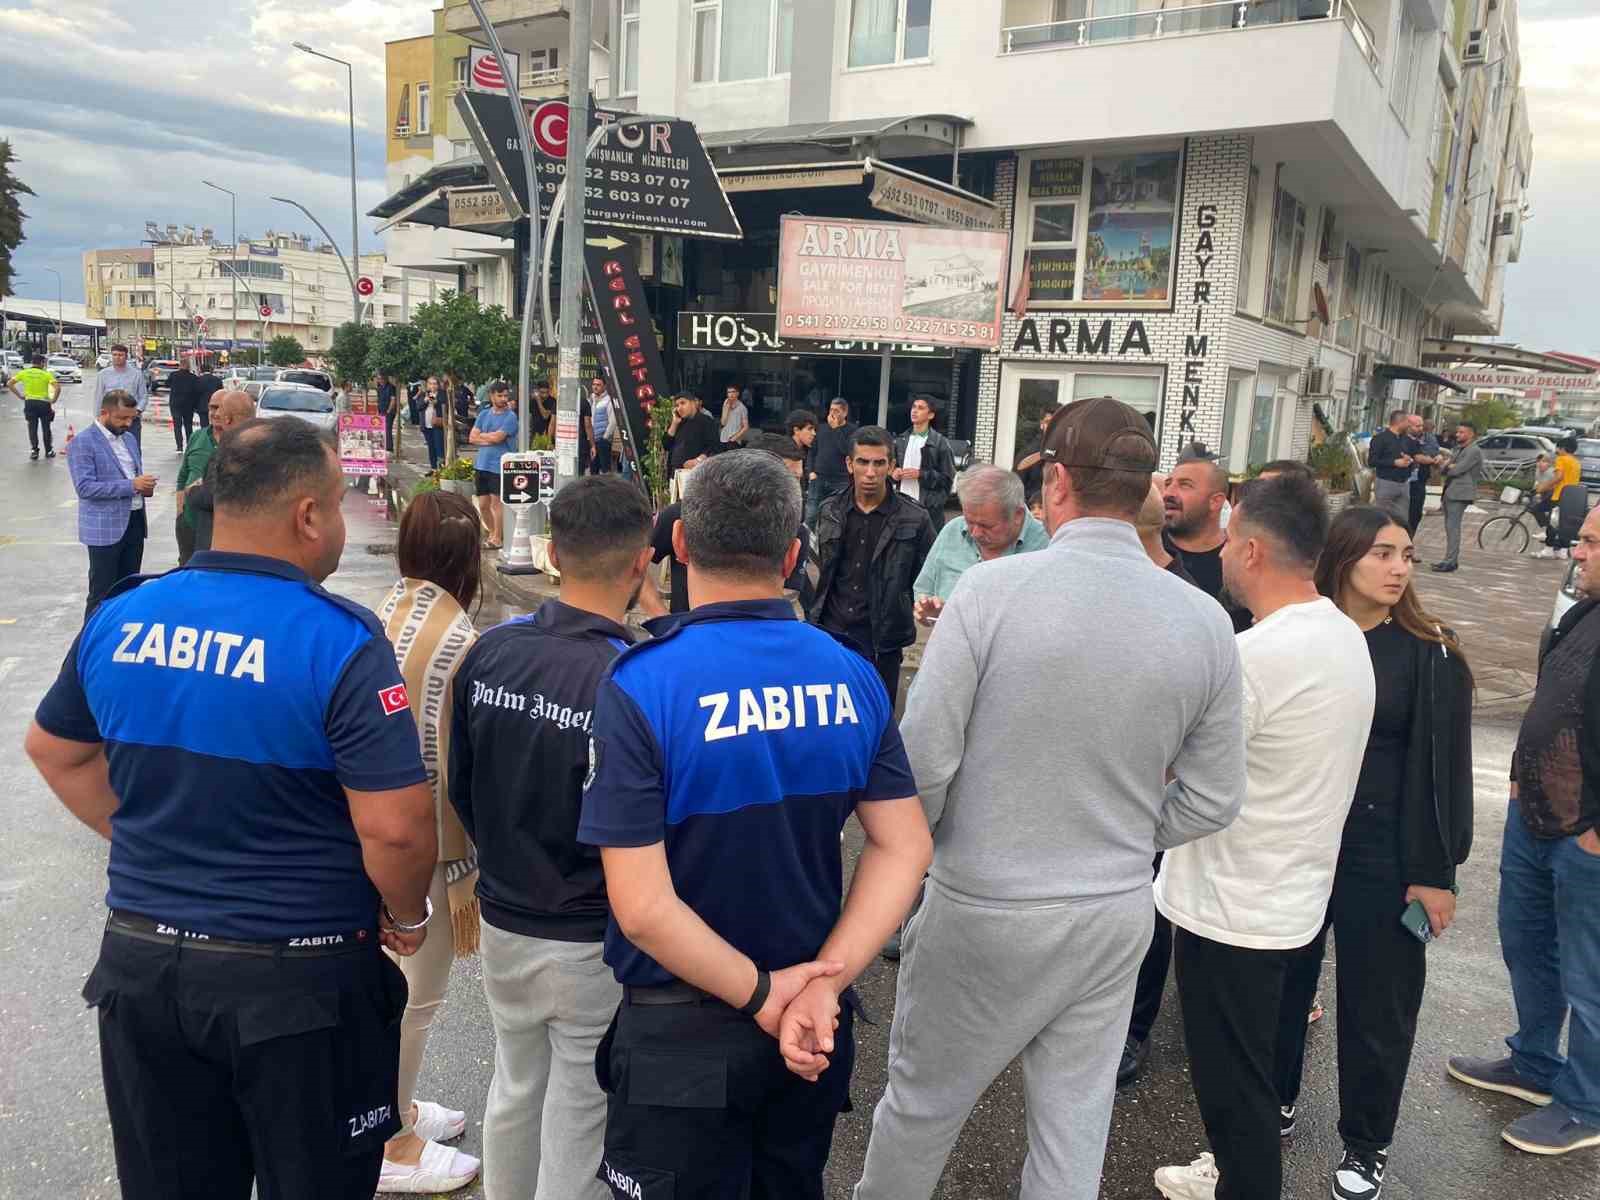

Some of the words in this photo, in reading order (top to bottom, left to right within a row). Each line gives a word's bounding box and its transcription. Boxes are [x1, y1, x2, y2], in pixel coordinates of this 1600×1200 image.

[642, 153, 689, 171] HİZMETLERİ
[584, 167, 604, 180] 52
[610, 169, 640, 184] 593
[645, 174, 665, 186] 07
[670, 177, 690, 190] 07
[455, 196, 478, 209] 0552
[536, 182, 563, 194] +9
[584, 186, 604, 199] 52
[609, 190, 640, 203] 603
[645, 194, 665, 206] 07
[670, 197, 690, 209] 07
[798, 223, 906, 262] ARMA
[785, 315, 792, 327] 0
[798, 315, 818, 327] 541
[961, 324, 976, 337] 25
[1013, 318, 1151, 355] ARMA
[1450, 372, 1493, 384] YIKAMA
[1496, 373, 1511, 384] VE
[1513, 373, 1535, 385] YAĞ
[112, 622, 266, 683] ZABITA
[471, 680, 526, 712] Palm
[529, 693, 593, 735] Angel
[698, 683, 860, 743] ZABITA
[288, 934, 344, 947] ZABITA
[348, 1103, 393, 1138] ZABITA
